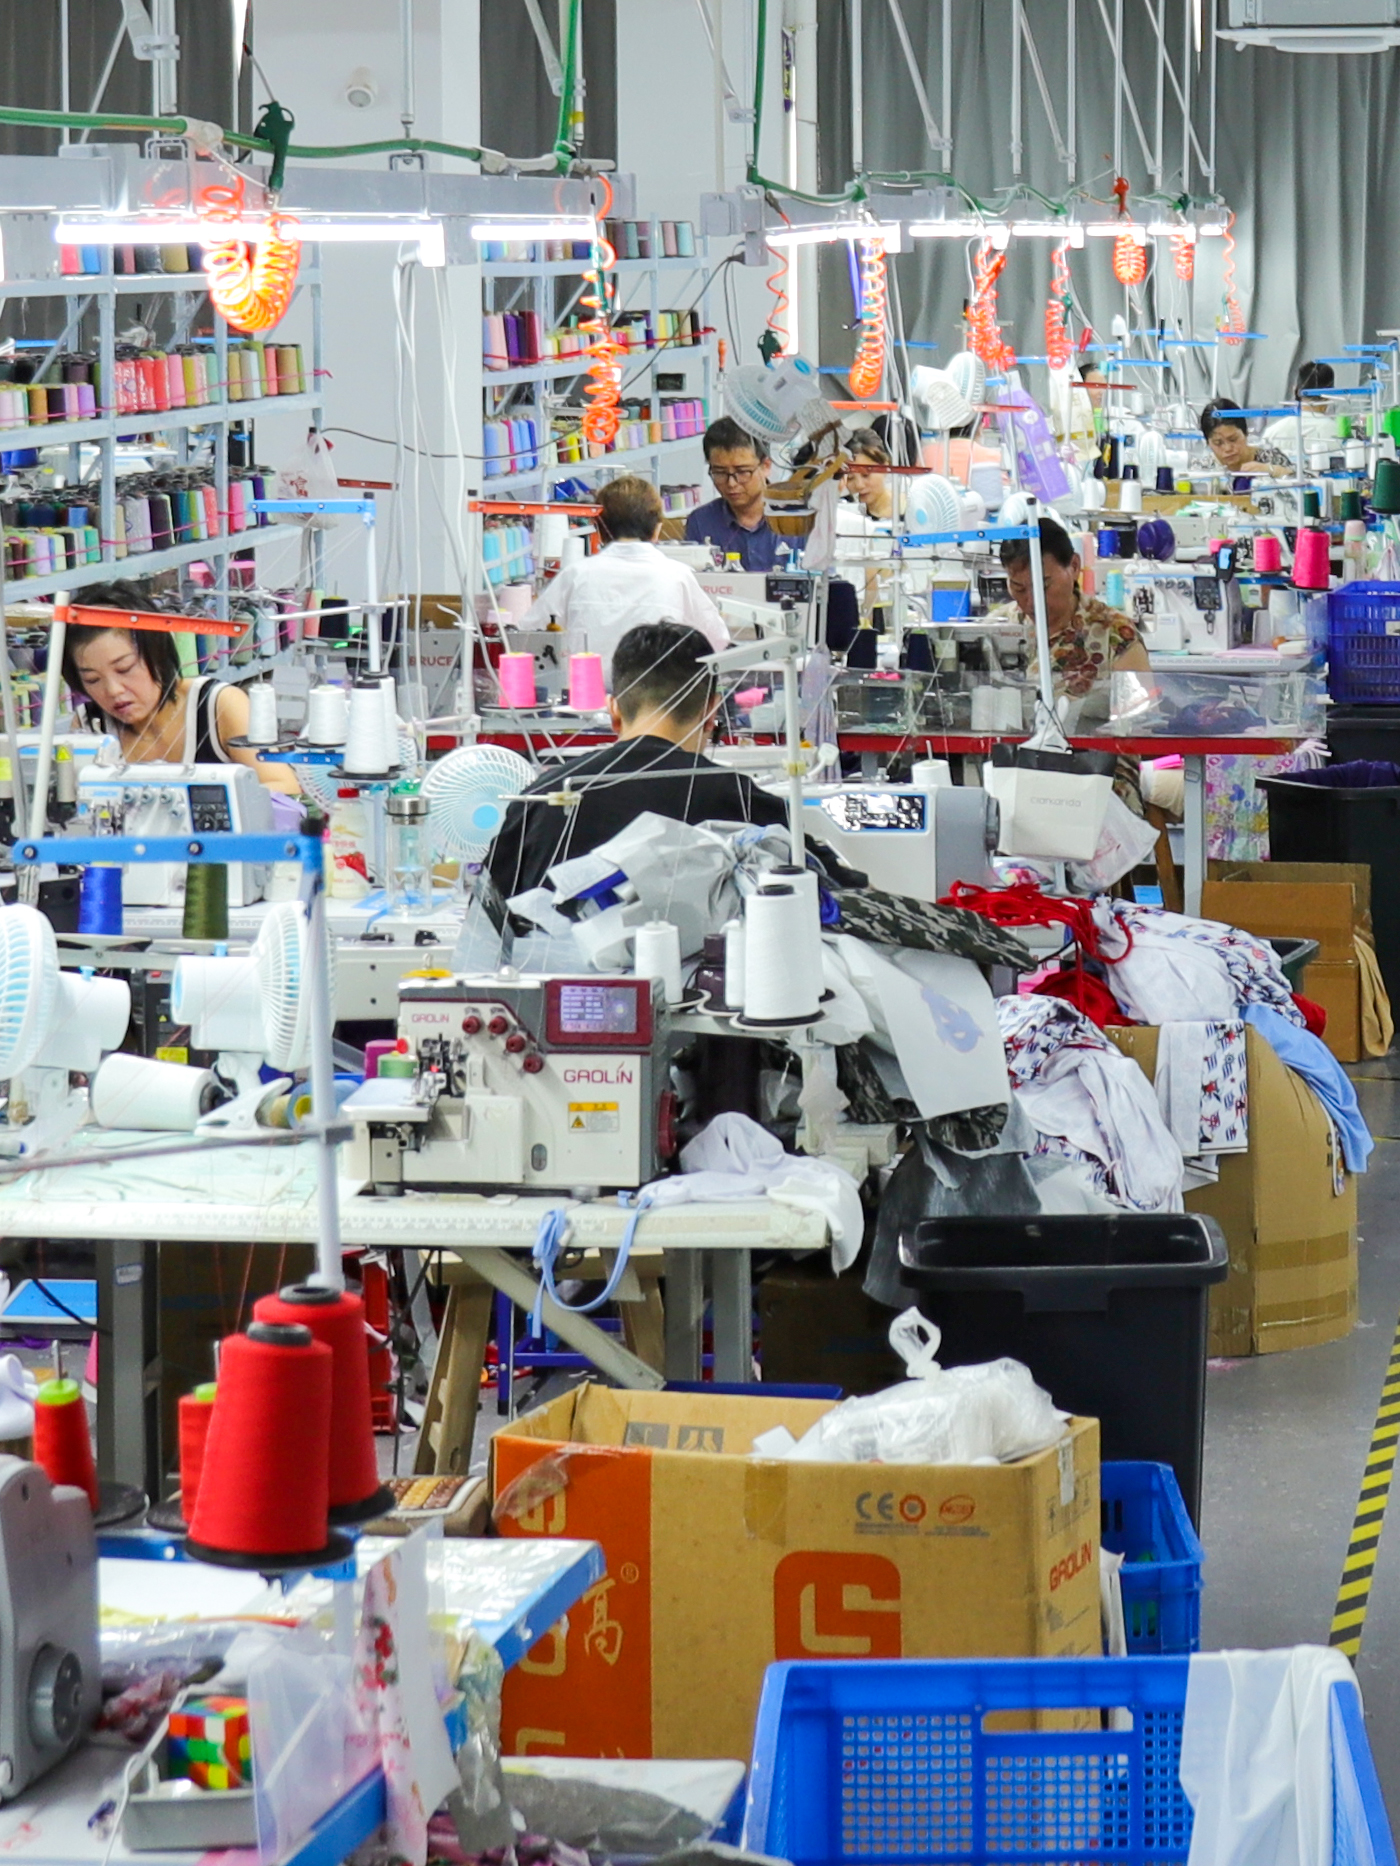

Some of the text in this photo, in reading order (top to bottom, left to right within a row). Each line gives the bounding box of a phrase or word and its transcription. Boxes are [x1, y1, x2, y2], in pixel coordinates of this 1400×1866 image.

[703, 585, 733, 595] RUCE
[409, 655, 453, 667] BRUCE
[563, 1062, 633, 1084] GAOLIN
[855, 1491, 894, 1520] CE
[1049, 1539, 1093, 1592] GAOLIN
